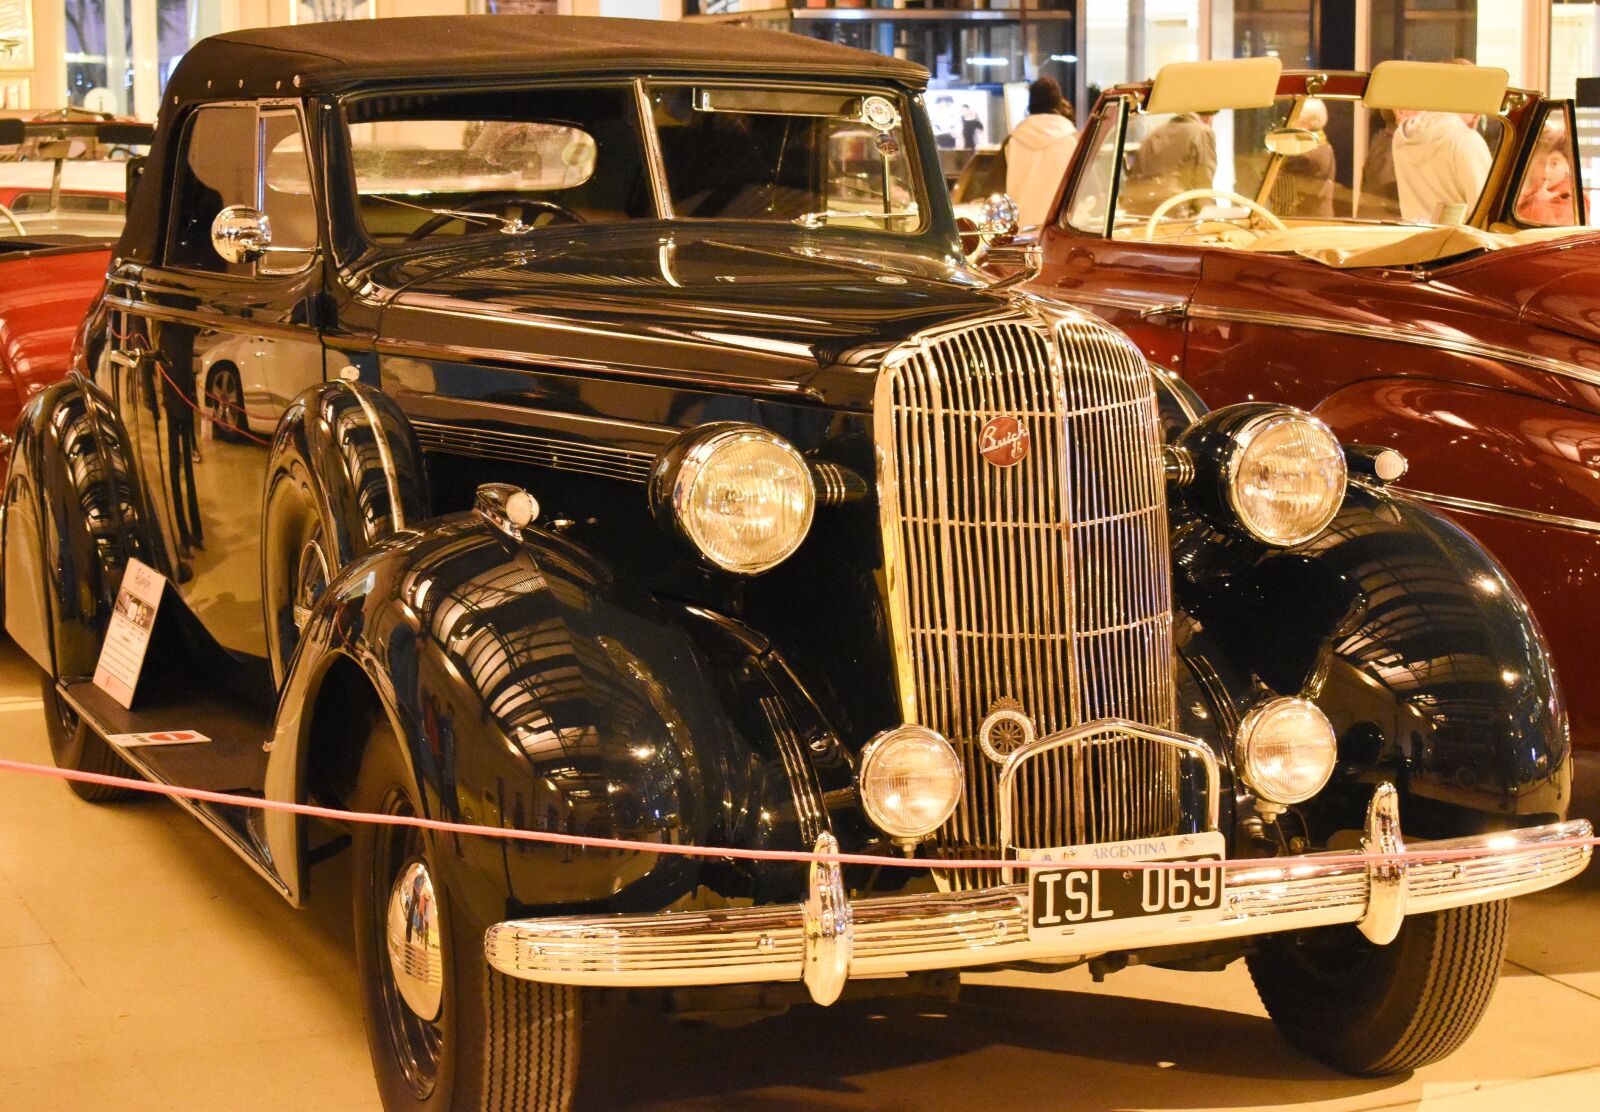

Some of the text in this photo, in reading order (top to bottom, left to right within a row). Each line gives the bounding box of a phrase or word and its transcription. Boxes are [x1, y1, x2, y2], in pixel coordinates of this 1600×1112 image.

[980, 420, 1030, 453] Buick
[1092, 842, 1167, 859] ARGENTINA
[1038, 858, 1217, 924] ISL 069
